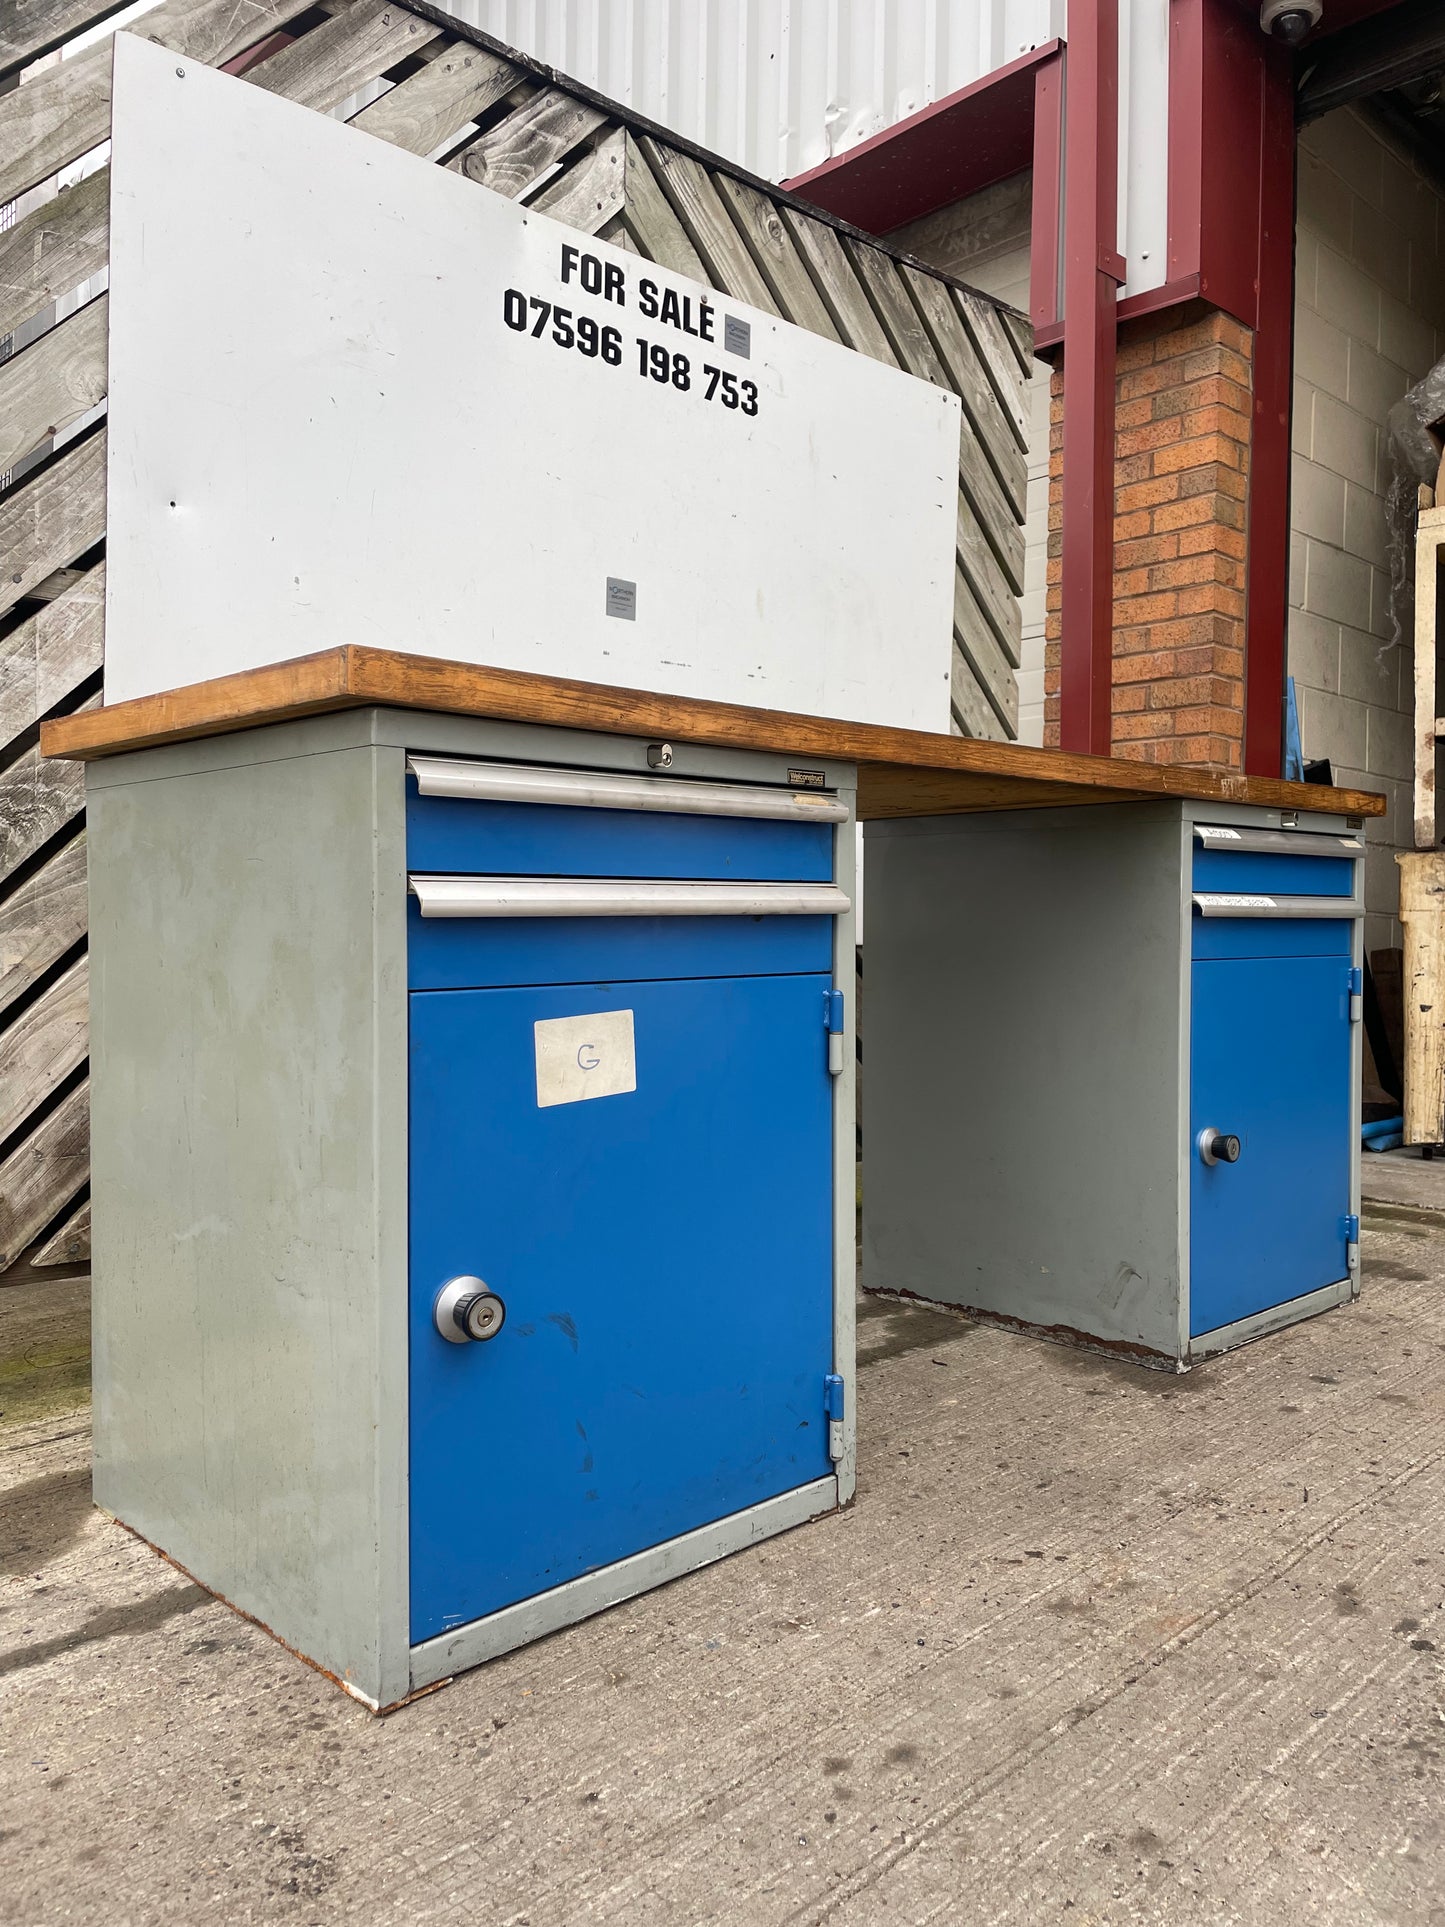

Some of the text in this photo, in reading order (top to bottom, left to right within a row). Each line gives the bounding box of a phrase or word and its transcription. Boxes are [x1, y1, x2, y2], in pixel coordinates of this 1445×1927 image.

[561, 243, 715, 343] FOR SALE
[503, 288, 759, 417] 07596 198 753
[577, 1044, 601, 1071] G
